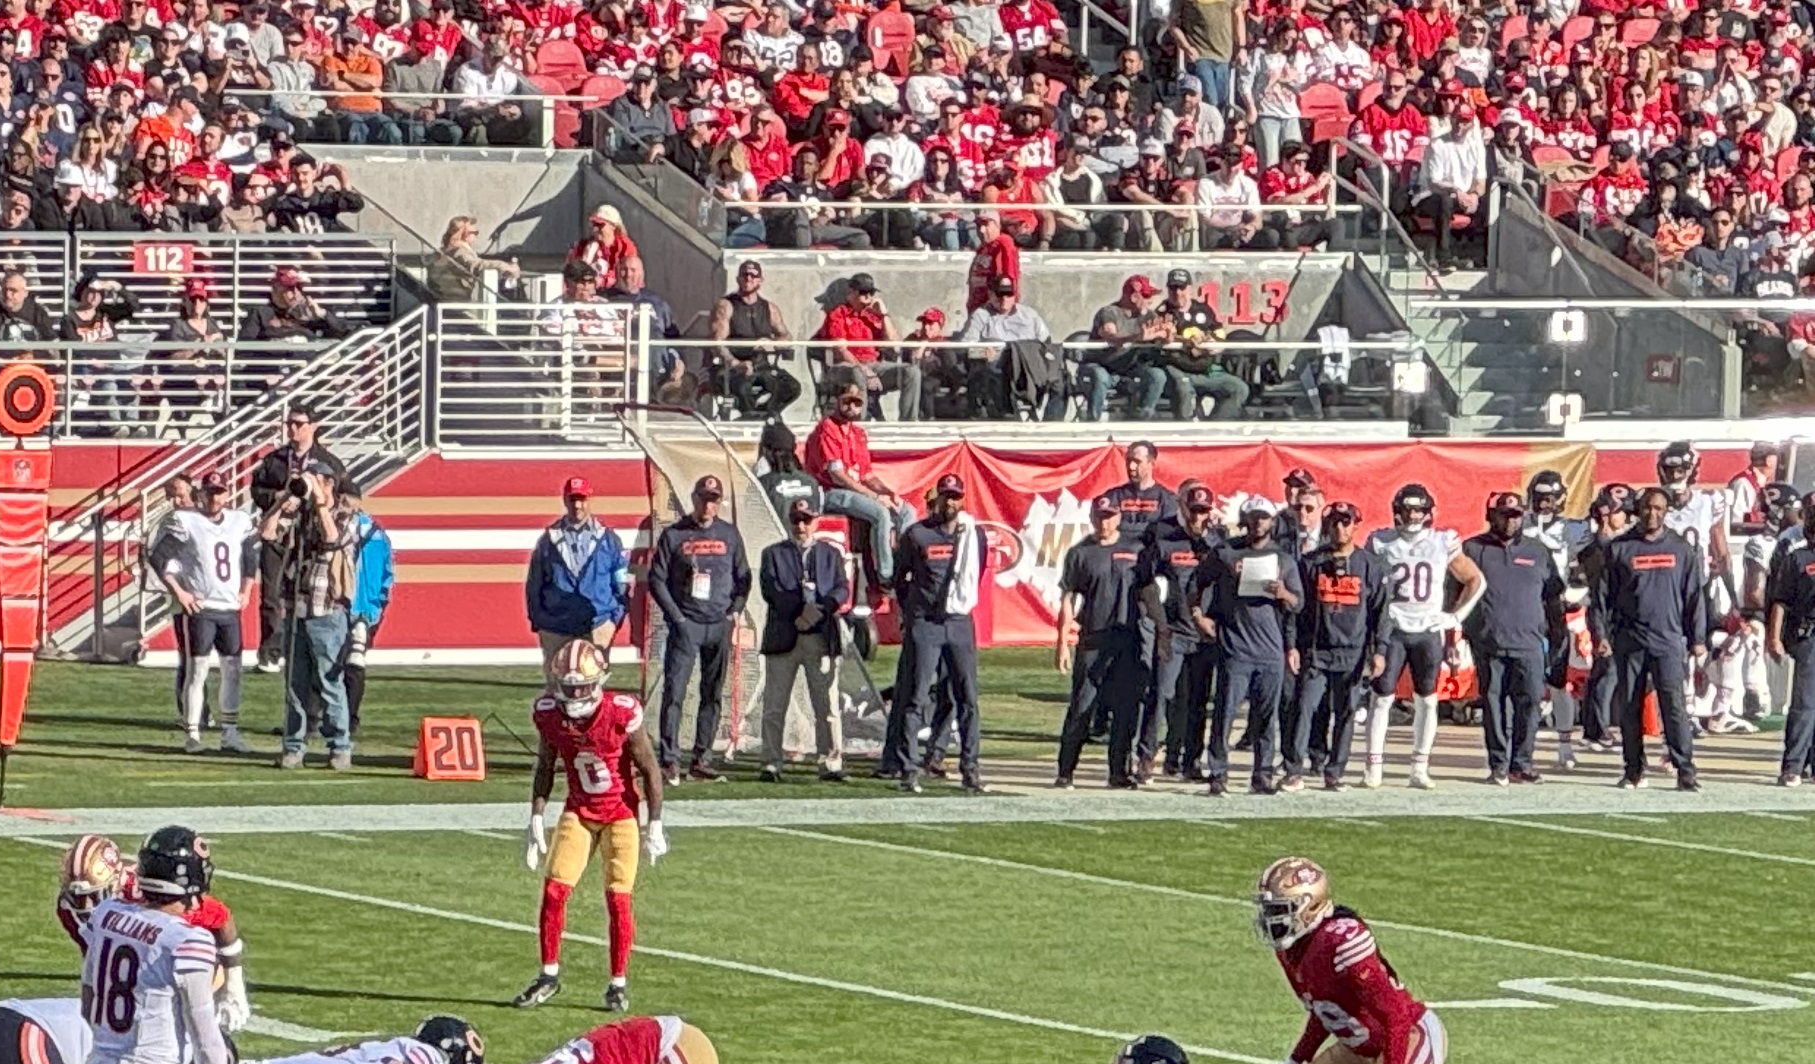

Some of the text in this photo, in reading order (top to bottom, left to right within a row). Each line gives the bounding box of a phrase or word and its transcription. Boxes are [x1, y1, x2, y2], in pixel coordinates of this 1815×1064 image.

[144, 247, 183, 271] 112
[1198, 280, 1290, 324] 113
[214, 541, 231, 582] 8
[1392, 561, 1433, 602] 20
[431, 726, 479, 771] 20
[573, 752, 614, 795] 0
[101, 909, 164, 946] WILLIAMS
[94, 936, 141, 1034] 18
